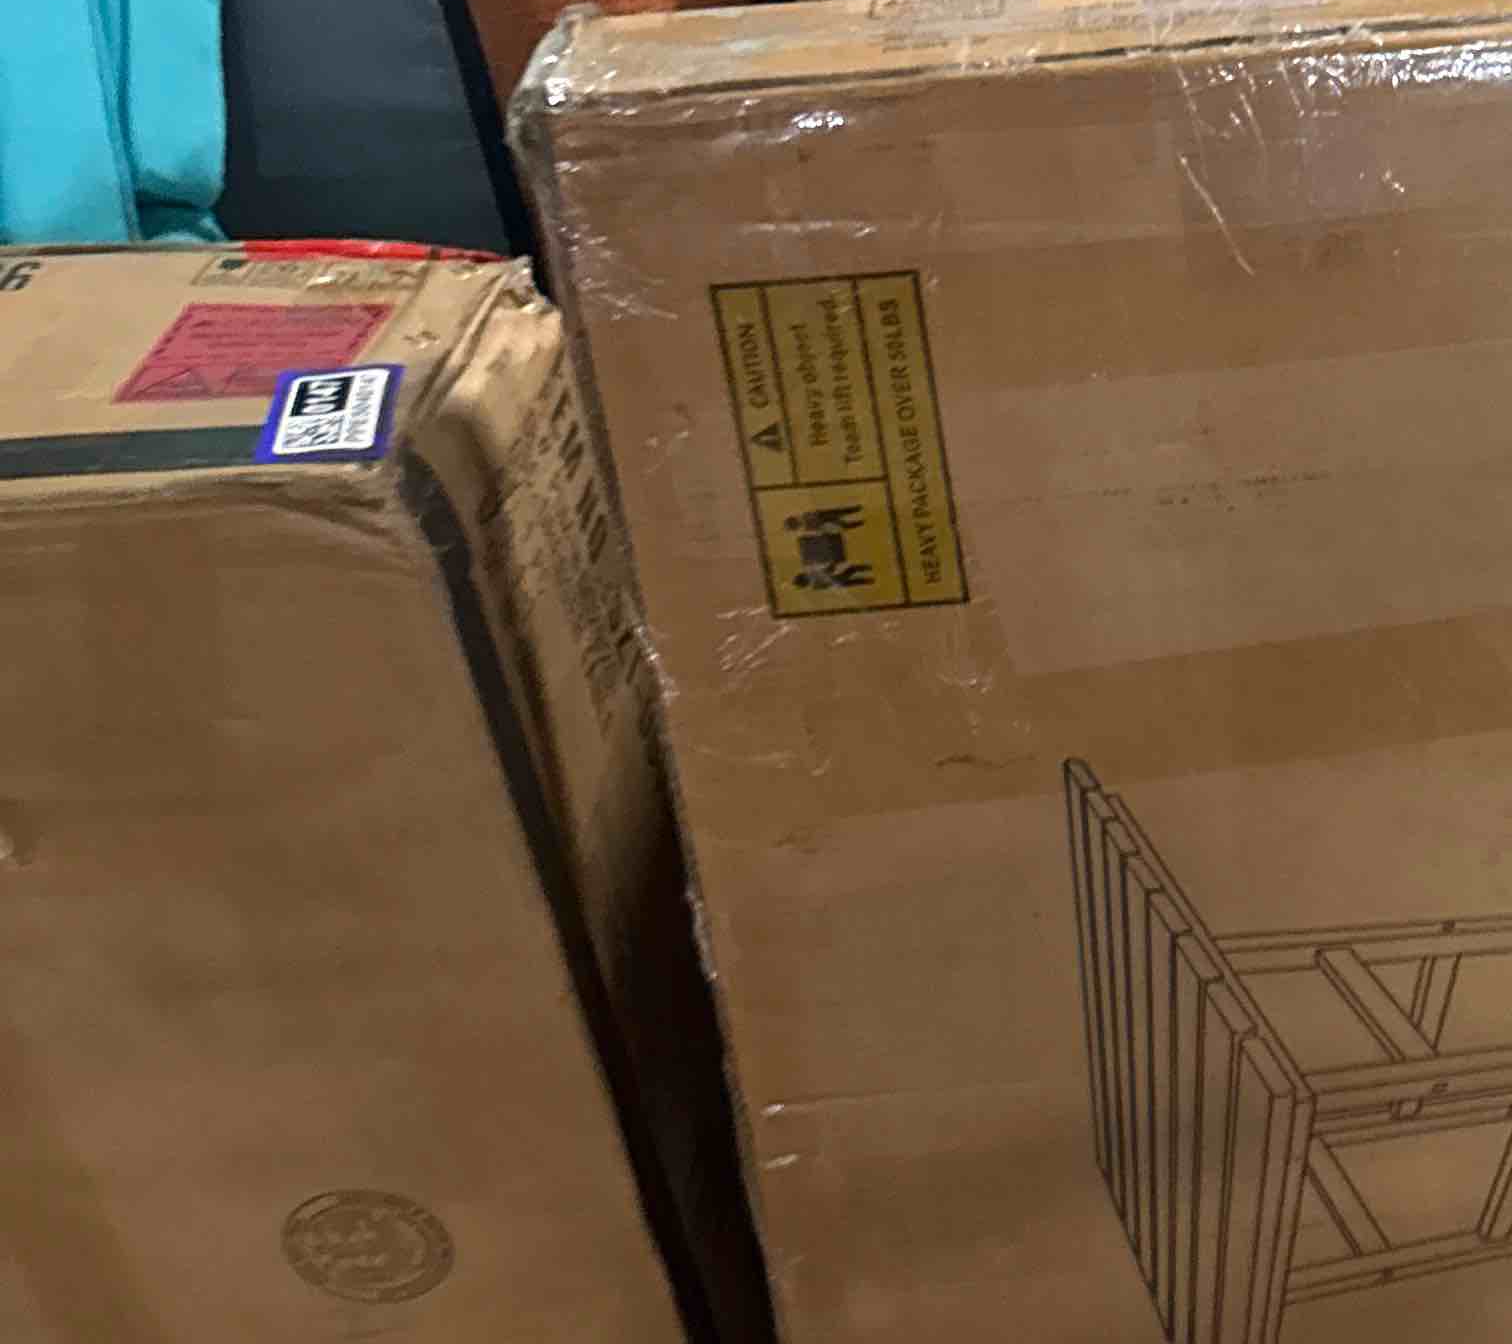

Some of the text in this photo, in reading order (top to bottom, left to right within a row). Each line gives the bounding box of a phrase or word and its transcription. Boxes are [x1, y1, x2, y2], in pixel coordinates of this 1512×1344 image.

[736, 322, 770, 409] CAUTION
[788, 320, 834, 447] Heavy object
[888, 365, 917, 423] OVER
[842, 416, 866, 465] Team
[899, 425, 932, 521] PACKAGE
[914, 522, 943, 585] HEAVY
